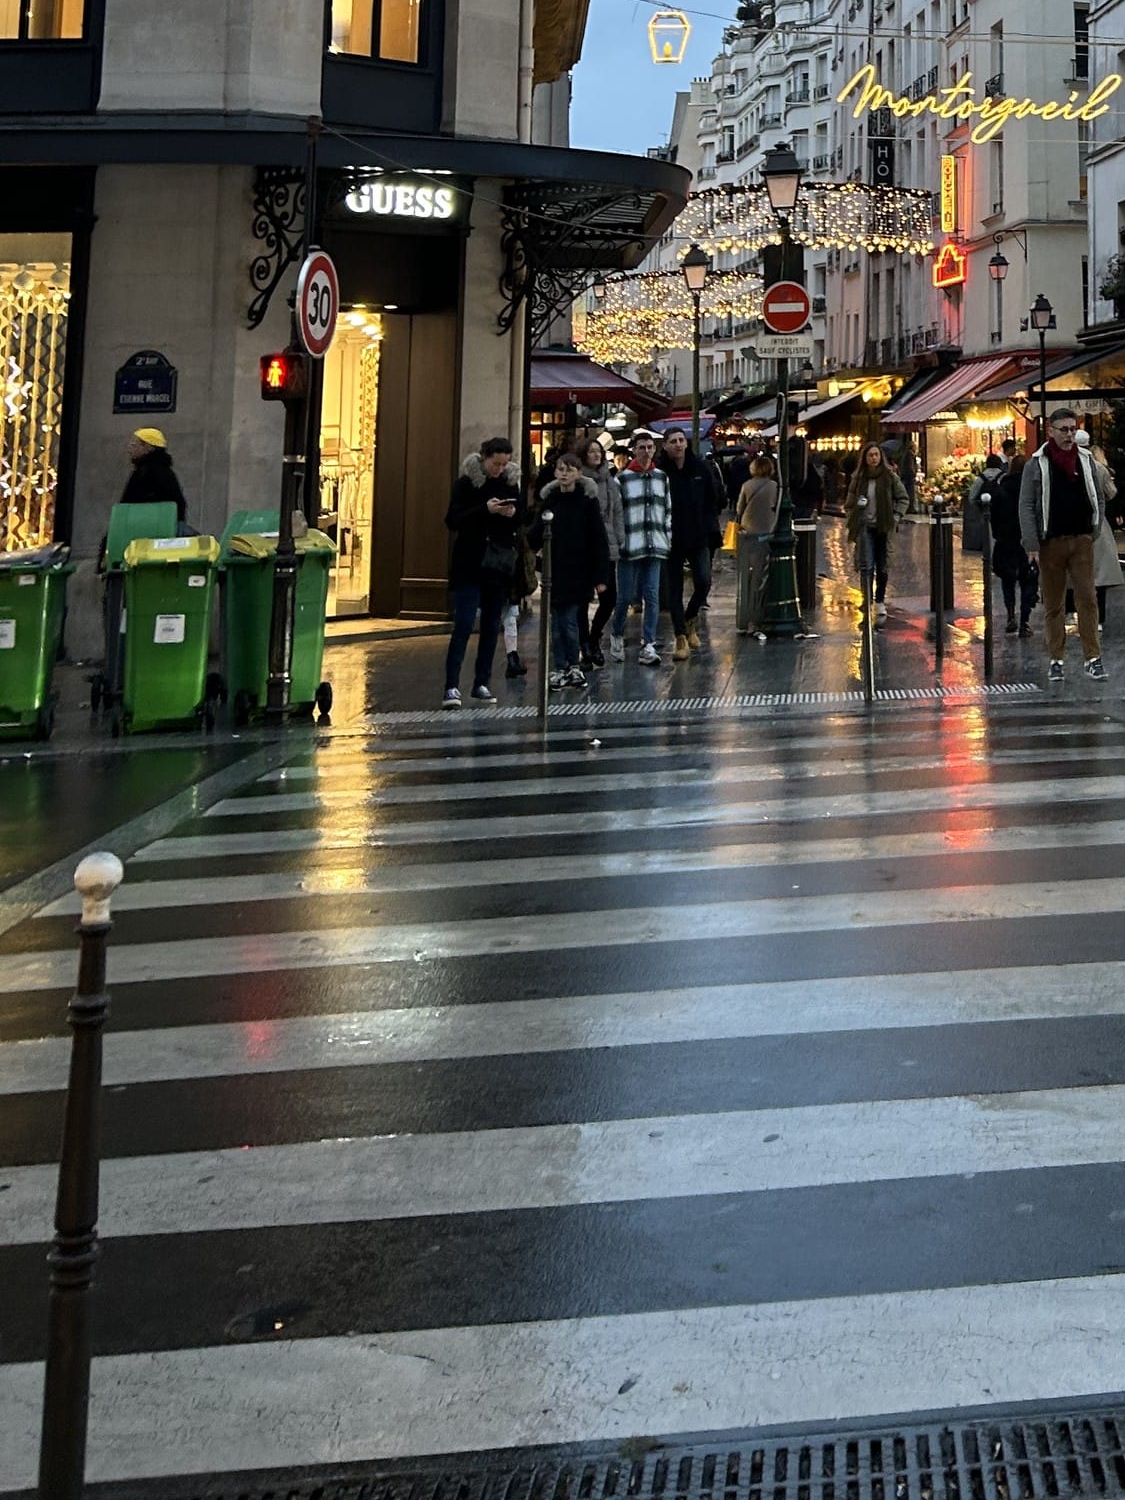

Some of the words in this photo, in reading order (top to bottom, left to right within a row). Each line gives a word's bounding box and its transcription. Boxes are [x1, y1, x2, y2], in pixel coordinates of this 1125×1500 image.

[836, 63, 1123, 145] Montorgueil
[345, 183, 454, 219] GUESS
[308, 281, 331, 328] 30
[770, 338, 799, 346] INTERDIT
[759, 347, 776, 355] SAUF
[777, 347, 810, 355] CYCLISTES
[138, 379, 153, 389] RUE
[145, 393, 170, 403] MARCEL
